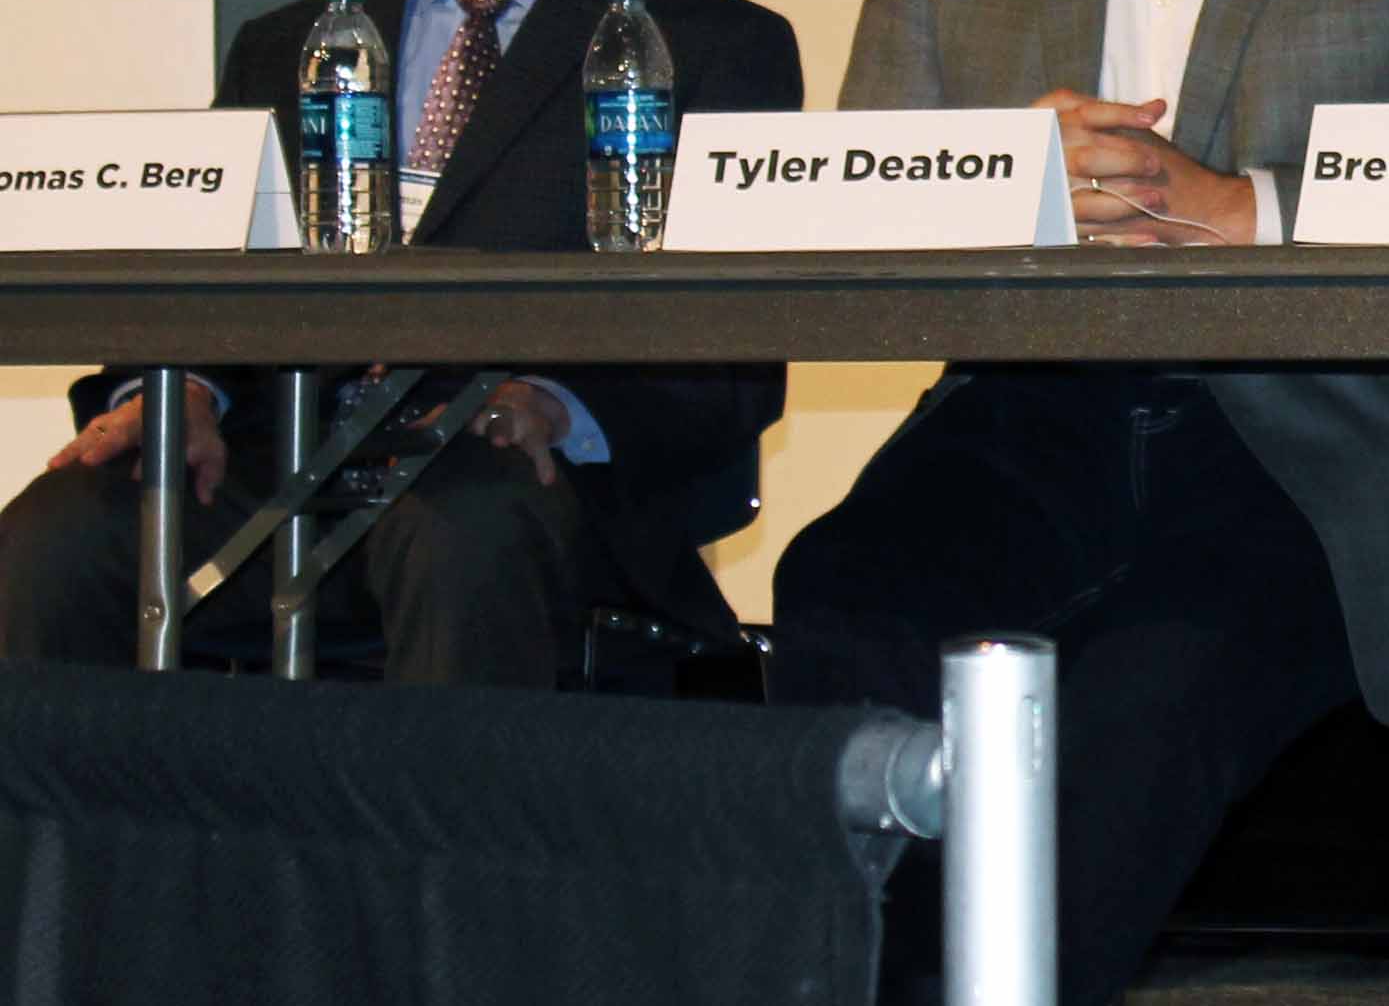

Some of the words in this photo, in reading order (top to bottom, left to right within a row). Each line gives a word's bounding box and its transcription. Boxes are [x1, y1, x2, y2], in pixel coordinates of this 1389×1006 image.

[600, 114, 669, 132] DAANI
[96, 163, 128, 189] C.
[140, 163, 224, 193] Berg
[708, 149, 828, 190] Tyler
[842, 149, 1013, 182] Deaton
